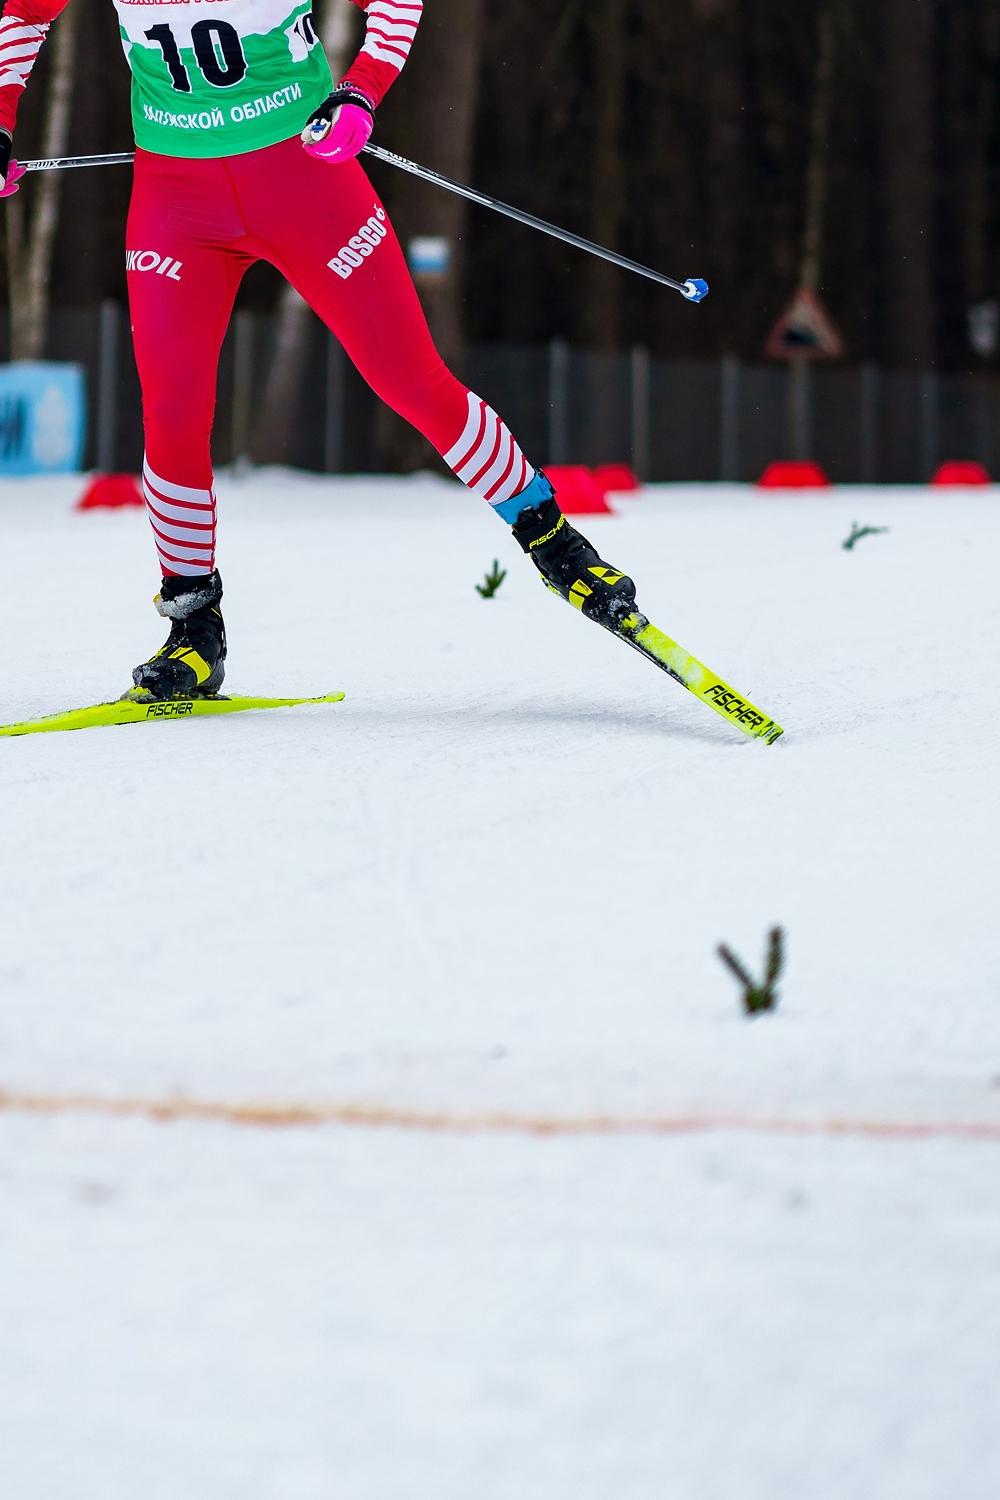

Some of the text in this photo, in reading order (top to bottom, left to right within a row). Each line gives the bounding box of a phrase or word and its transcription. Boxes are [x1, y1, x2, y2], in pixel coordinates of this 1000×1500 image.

[143, 19, 248, 93] 10
[230, 82, 302, 123] ОБЛАСТИ
[26, 160, 62, 170] SWIX
[326, 216, 388, 280] BOSCO
[145, 702, 194, 718] FISCHER
[703, 684, 765, 730] FISCHER
